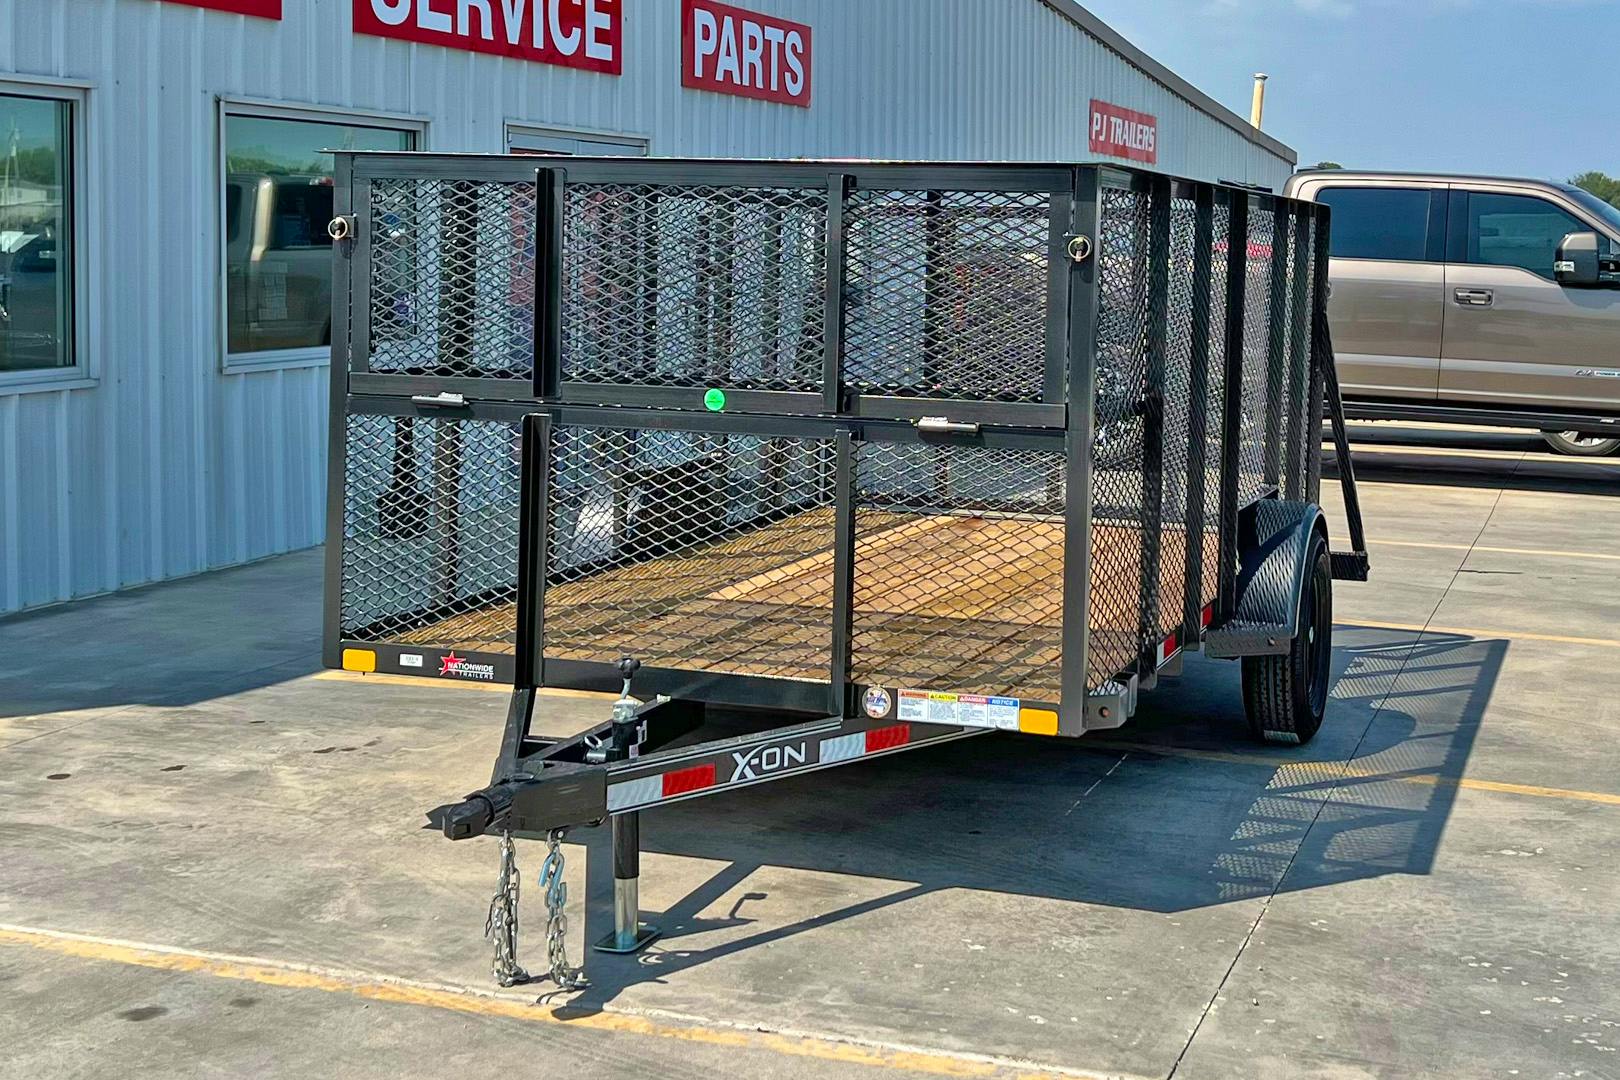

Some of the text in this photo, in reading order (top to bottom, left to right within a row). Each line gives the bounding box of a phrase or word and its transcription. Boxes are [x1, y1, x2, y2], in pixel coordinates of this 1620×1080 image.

[694, 8, 804, 96] PARTS
[1092, 112, 1155, 152] PJ TRAILERS
[447, 662, 494, 673] NATIONWIDE
[459, 670, 494, 680] TRAILERS
[730, 742, 806, 783] X-ON
